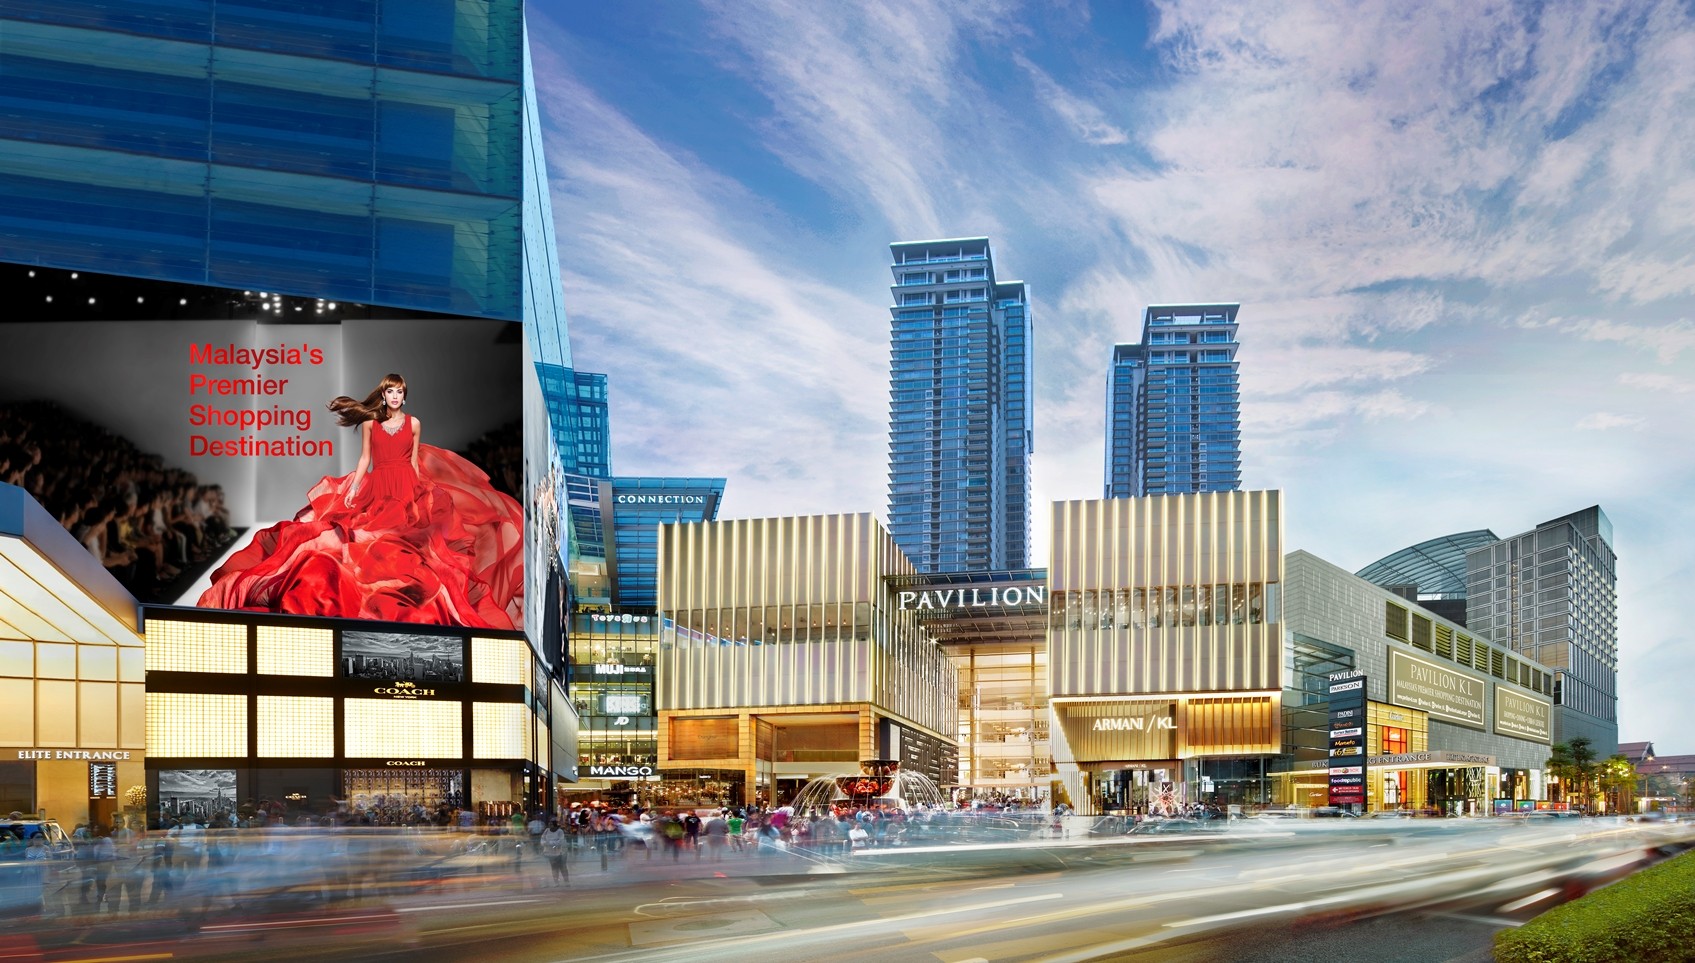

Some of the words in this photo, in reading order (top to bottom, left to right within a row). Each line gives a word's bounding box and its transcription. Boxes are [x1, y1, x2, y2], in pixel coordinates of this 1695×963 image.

[189, 343, 324, 370] Malaysia's
[189, 374, 288, 395] Premier
[189, 404, 311, 431] Shopping
[190, 435, 333, 457] Destination
[618, 495, 703, 504] CONNECTION
[899, 585, 1044, 611] PAVILION
[596, 663, 623, 674] MUJI
[1329, 669, 1364, 681] PAVILION
[1411, 664, 1456, 690] PAVILION
[374, 687, 435, 696] COACH
[1331, 682, 1360, 691] PARKSON
[1435, 689, 1455, 703] SHOPPING
[1455, 695, 1482, 710] DESTINATION
[1505, 696, 1534, 713] PAVILION
[614, 716, 629, 725] JD
[1093, 718, 1144, 731] ARMANI
[1157, 716, 1178, 729] KL
[18, 750, 51, 759] ELITE
[56, 750, 130, 760] ENTRANCE
[1379, 754, 1431, 764] ENTRANCE
[591, 766, 652, 775] MANGO
